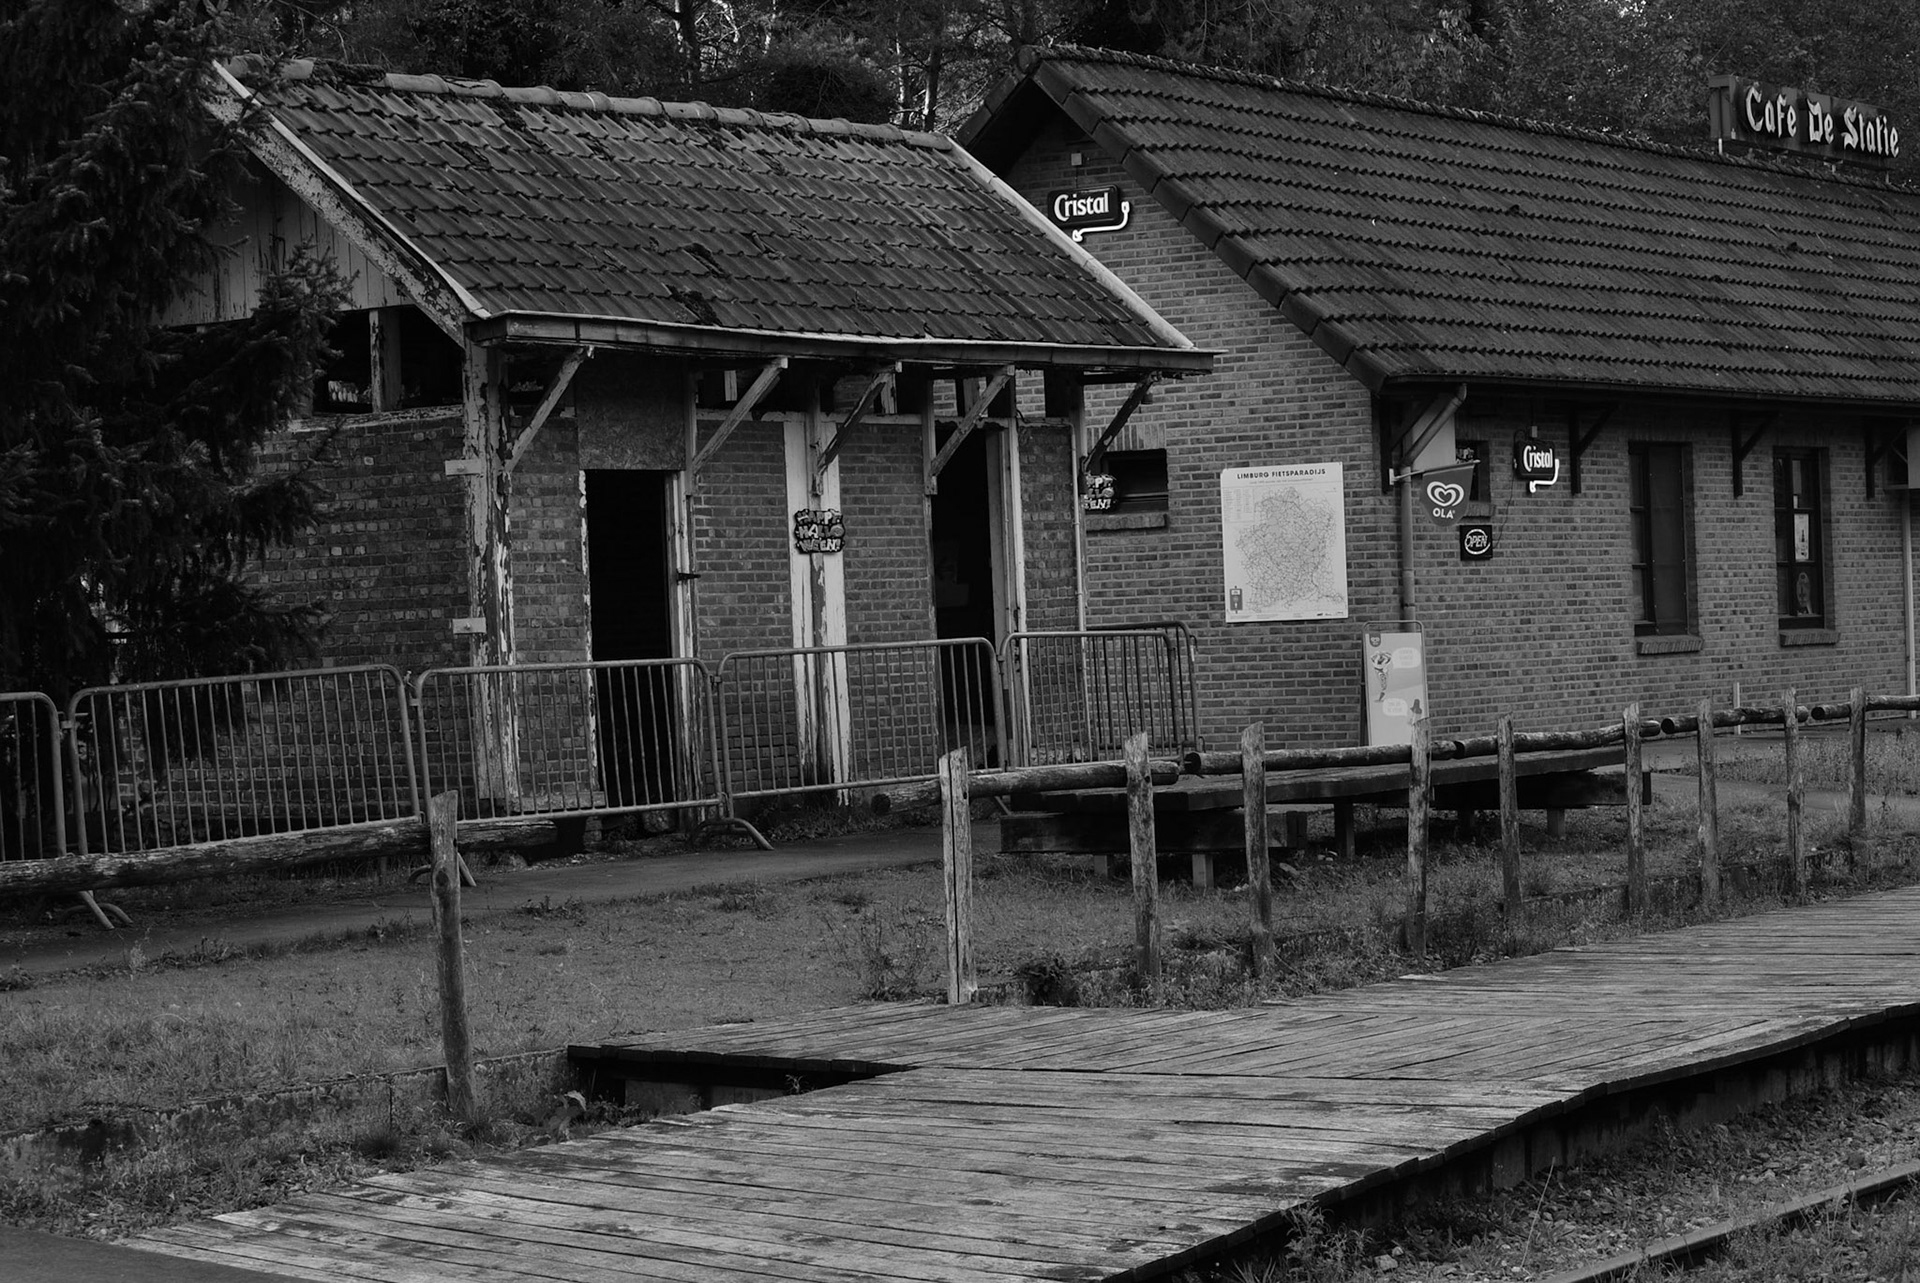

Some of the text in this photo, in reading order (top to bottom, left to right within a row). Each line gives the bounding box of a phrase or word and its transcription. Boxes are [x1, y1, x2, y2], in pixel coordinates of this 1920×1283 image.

[1806, 98, 1834, 144] De
[1054, 192, 1109, 222] Cristal
[1522, 445, 1553, 473] Cristal
[1237, 468, 1326, 480] LIMBURG FIETSPARADIJS
[1432, 507, 1454, 519] OLA
[1464, 535, 1488, 548] OPEN
